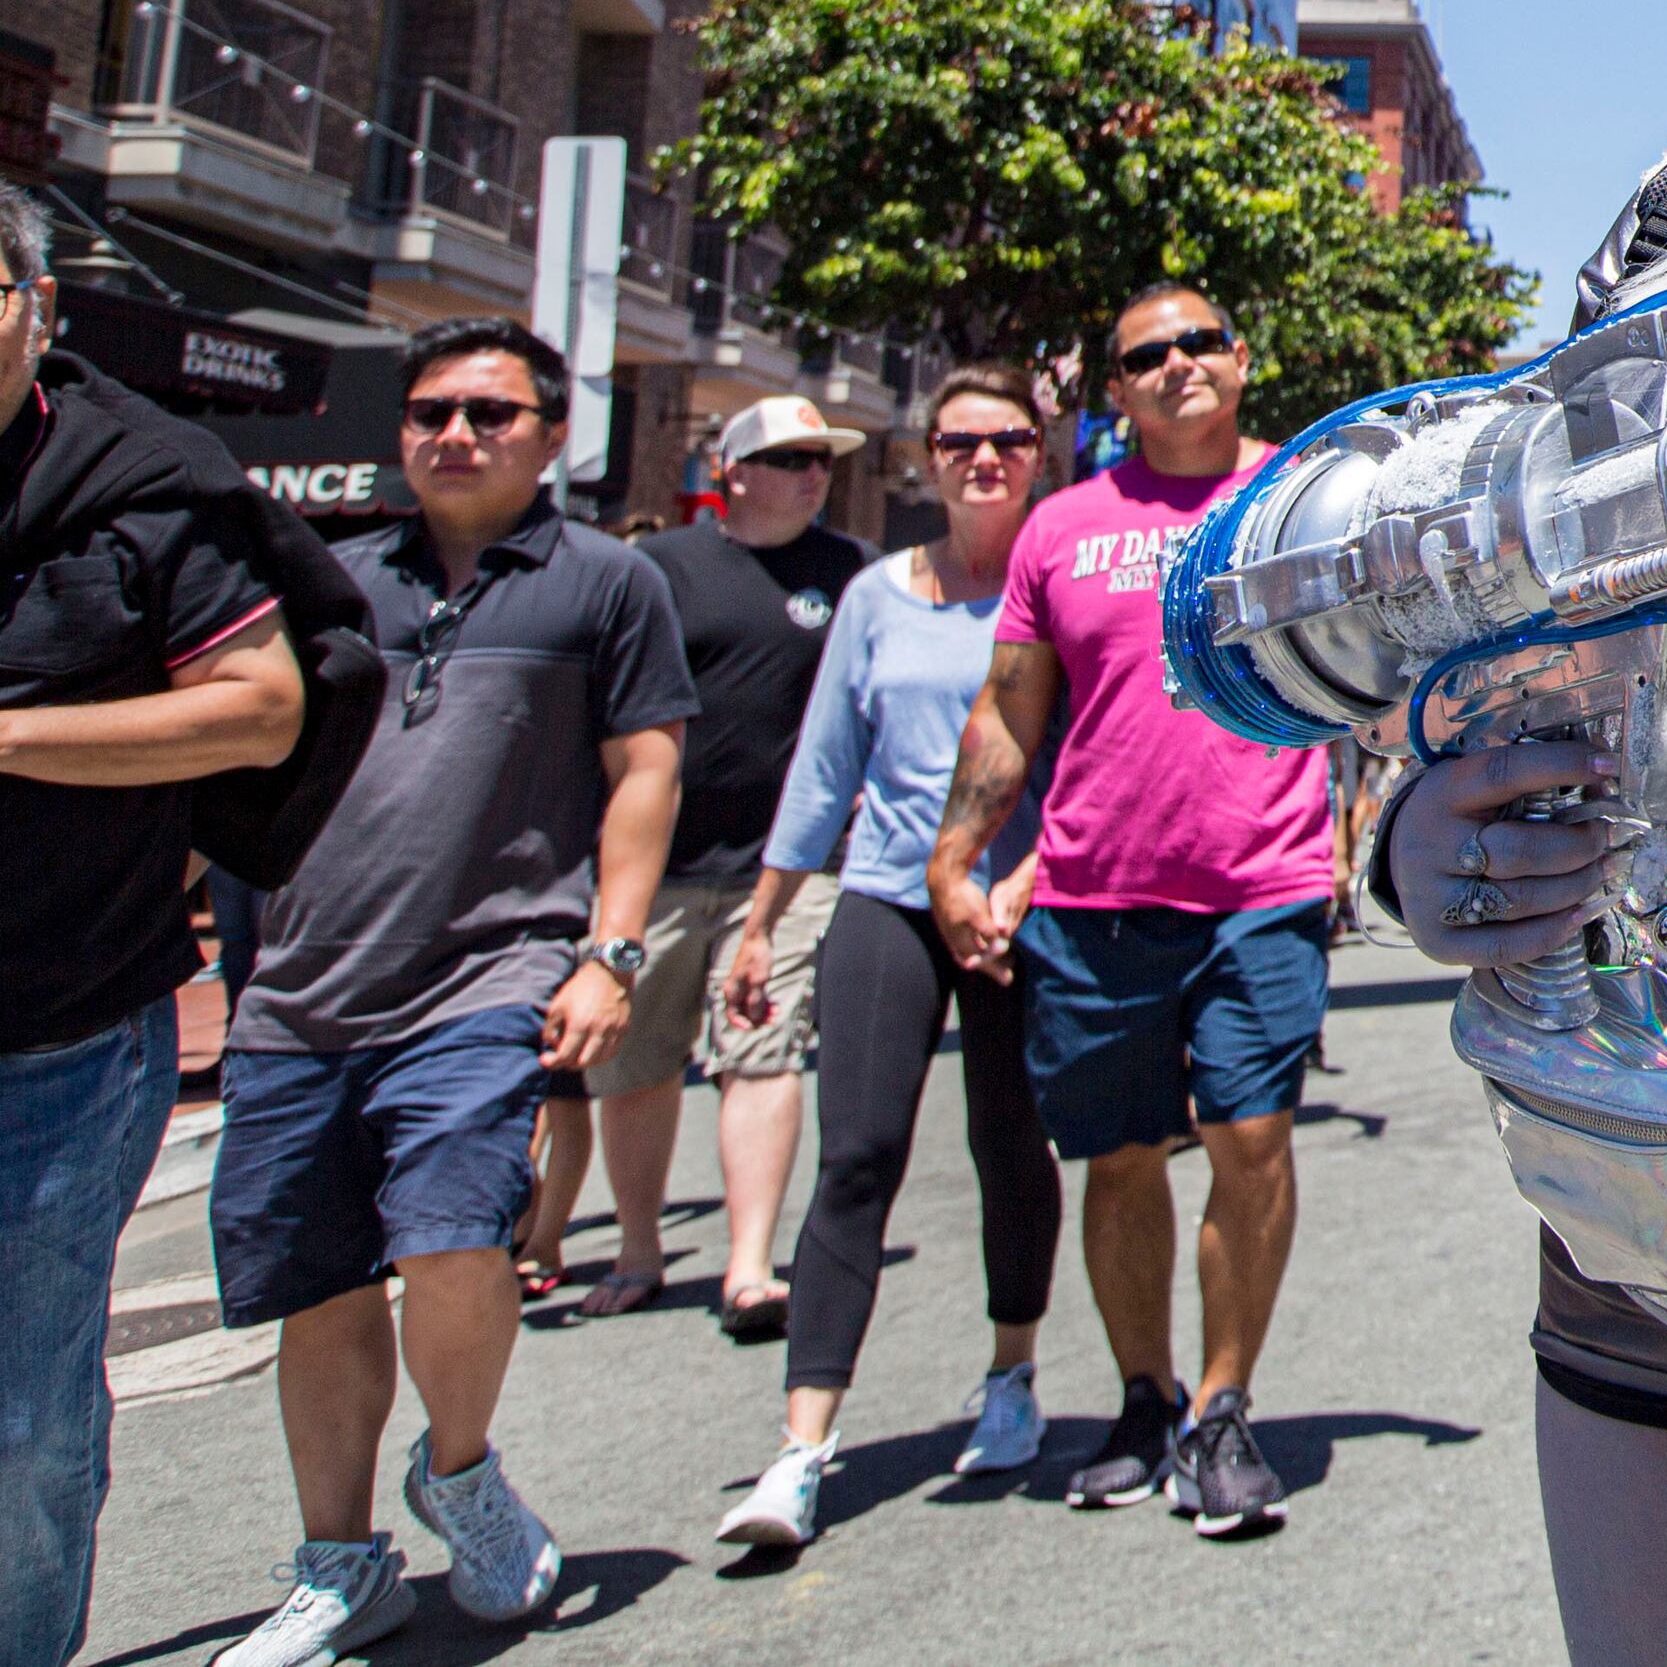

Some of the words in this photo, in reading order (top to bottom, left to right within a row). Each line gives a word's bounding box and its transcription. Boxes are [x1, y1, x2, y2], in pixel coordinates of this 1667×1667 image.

[184, 332, 281, 368] EXOTIC
[182, 352, 287, 392] DRINKS
[1071, 533, 1120, 580] MY
